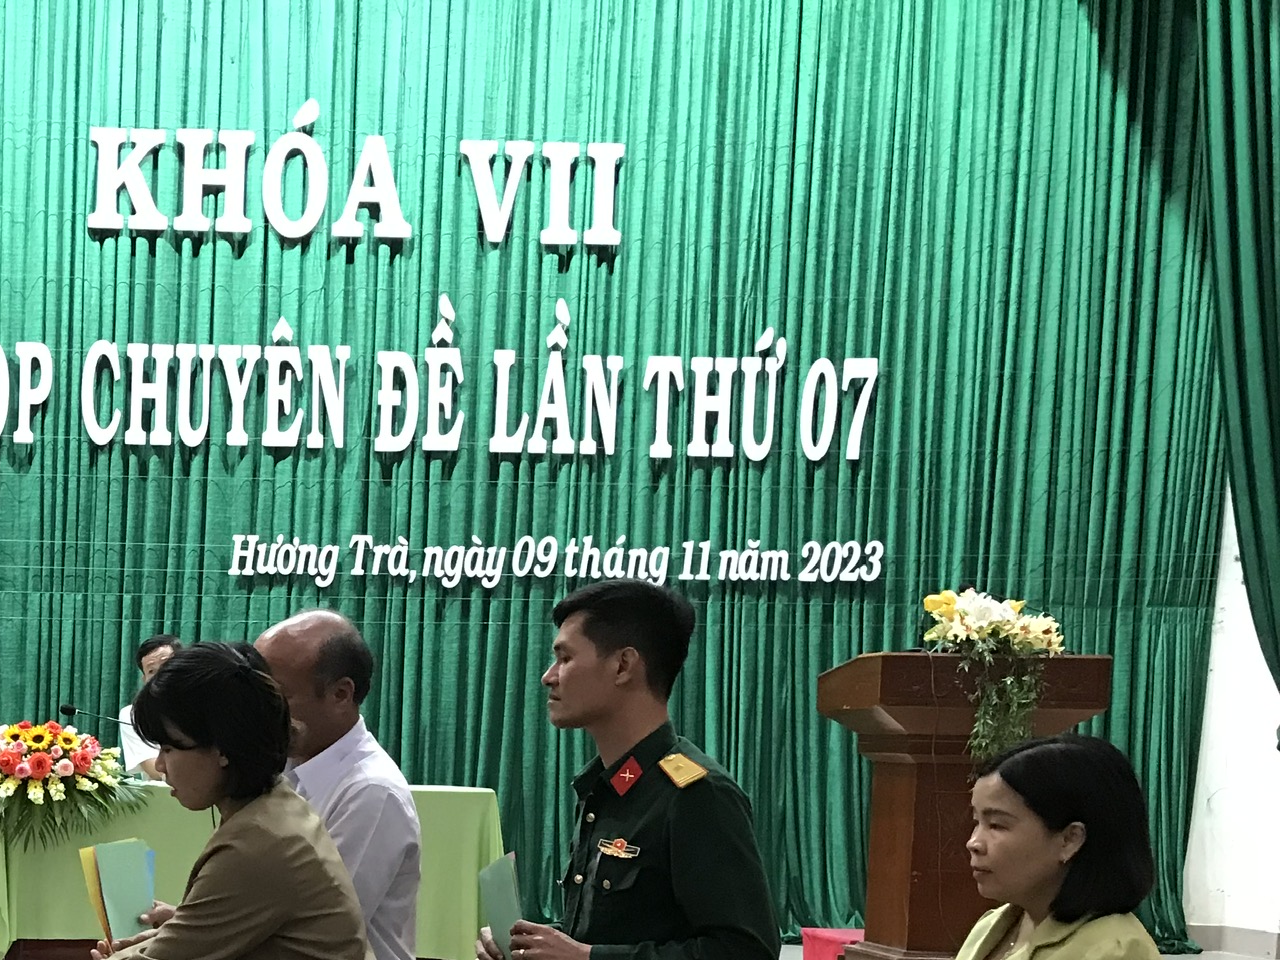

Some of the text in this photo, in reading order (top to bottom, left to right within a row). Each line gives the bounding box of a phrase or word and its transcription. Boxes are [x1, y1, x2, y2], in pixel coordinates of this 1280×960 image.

[86, 98, 626, 246] KHÓA VII
[81, 315, 351, 449] CHUYÊN
[374, 293, 465, 452] ĐỀ
[489, 297, 624, 456] LẦN
[642, 326, 787, 462] THỨ
[799, 357, 879, 461] 07
[227, 533, 340, 588] Hương
[421, 534, 507, 589] ngày
[511, 535, 558, 578] 09
[564, 534, 670, 587] tháng
[678, 540, 711, 581] 11
[718, 538, 791, 581] năm
[797, 540, 884, 583] 2023
